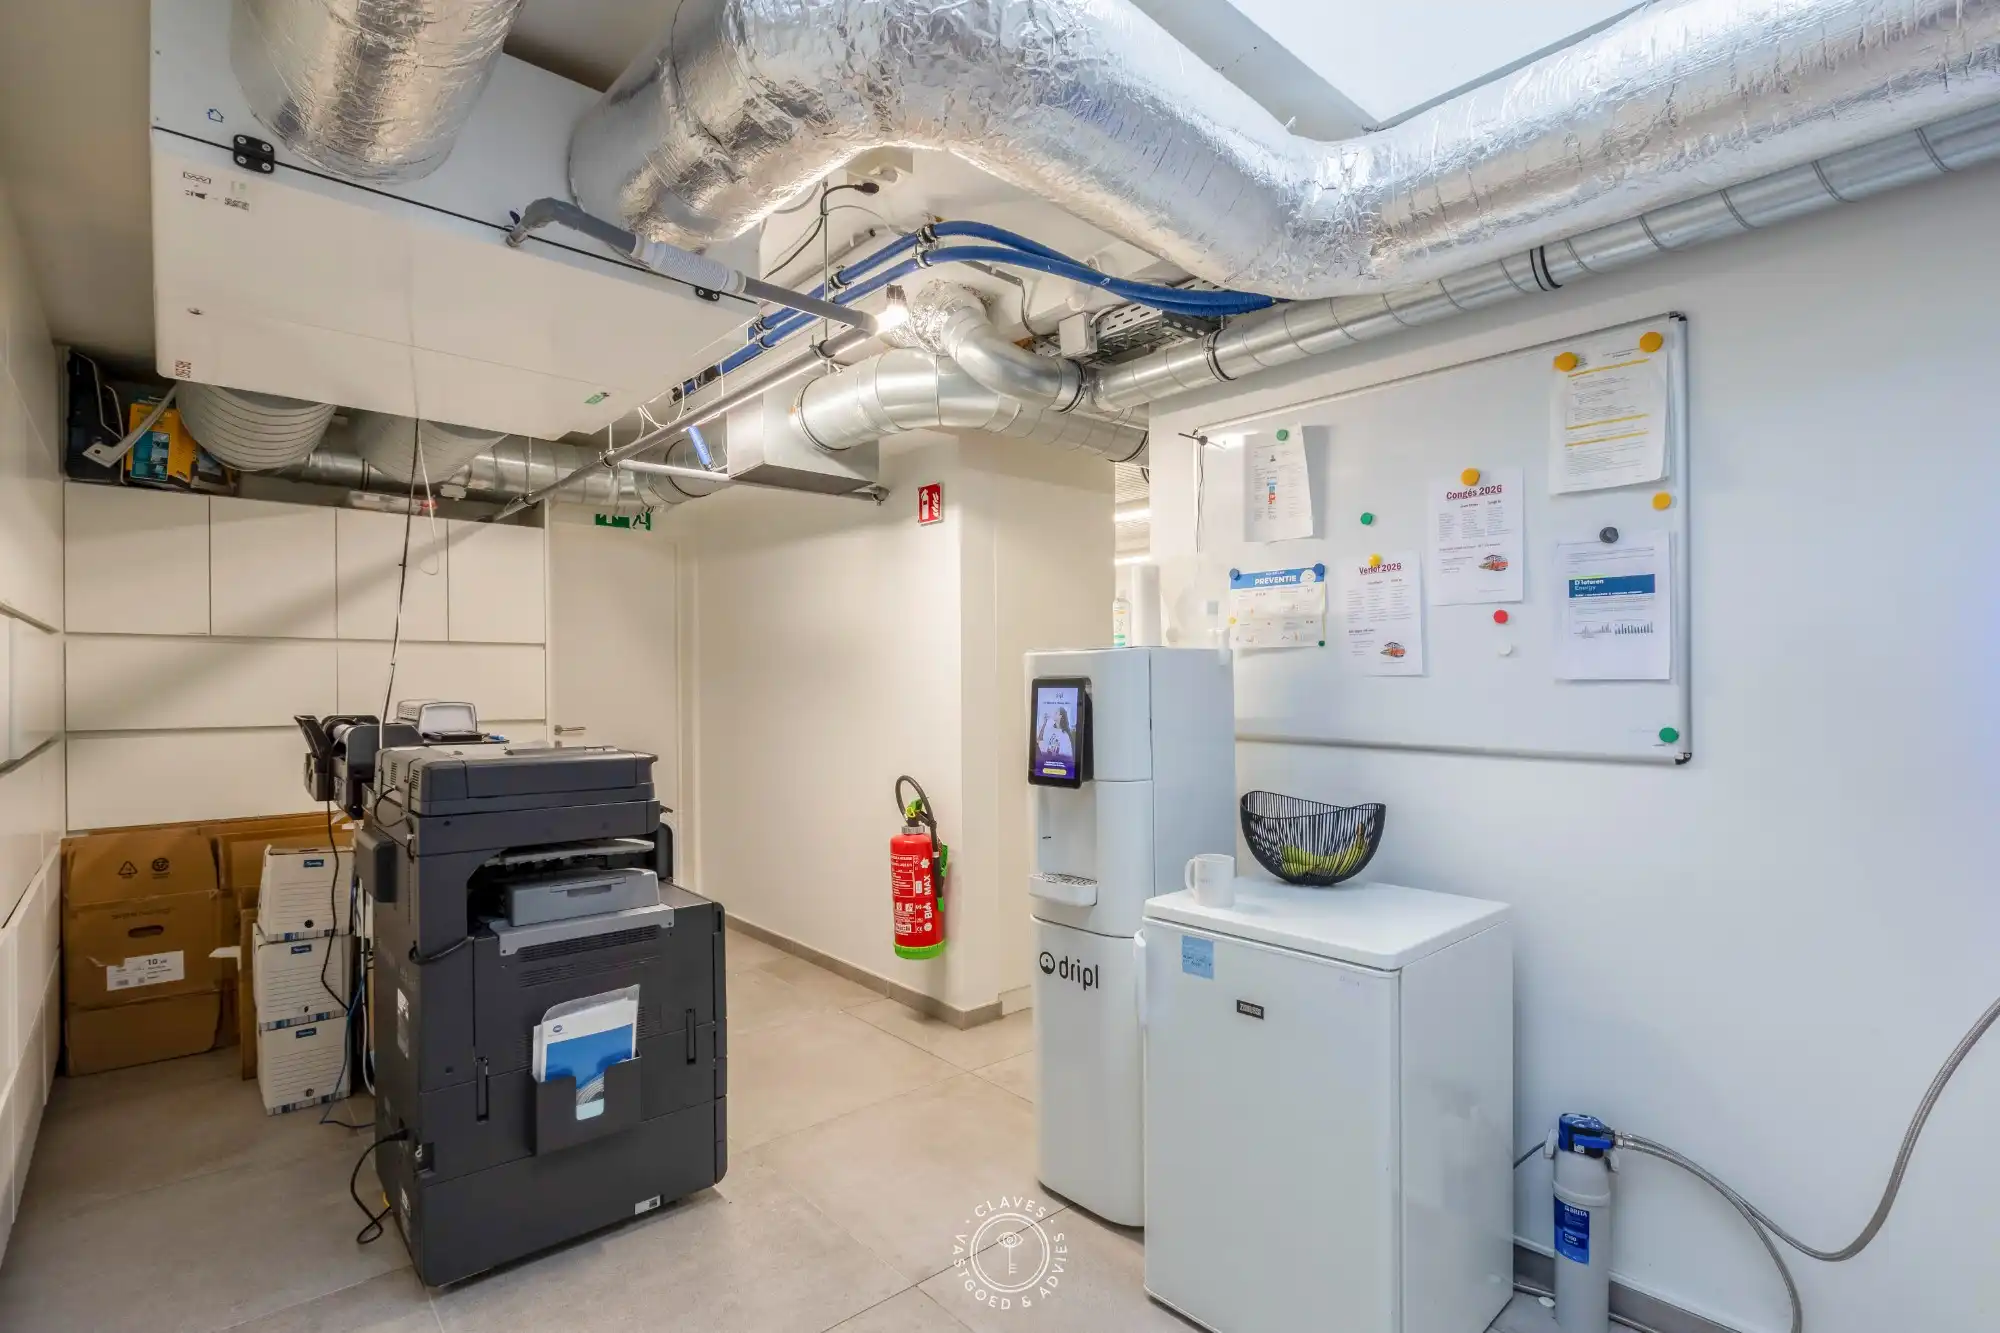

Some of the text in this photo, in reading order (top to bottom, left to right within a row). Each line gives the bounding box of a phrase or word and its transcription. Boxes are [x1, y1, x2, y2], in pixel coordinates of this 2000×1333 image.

[1446, 484, 1502, 500] Congés 2026
[1359, 562, 1402, 575] Verlof 2026
[1254, 574, 1297, 586] PREVENTIE
[923, 874, 932, 896] MAX
[1059, 955, 1099, 991] dripl
[1569, 1207, 1588, 1218] BRITA
